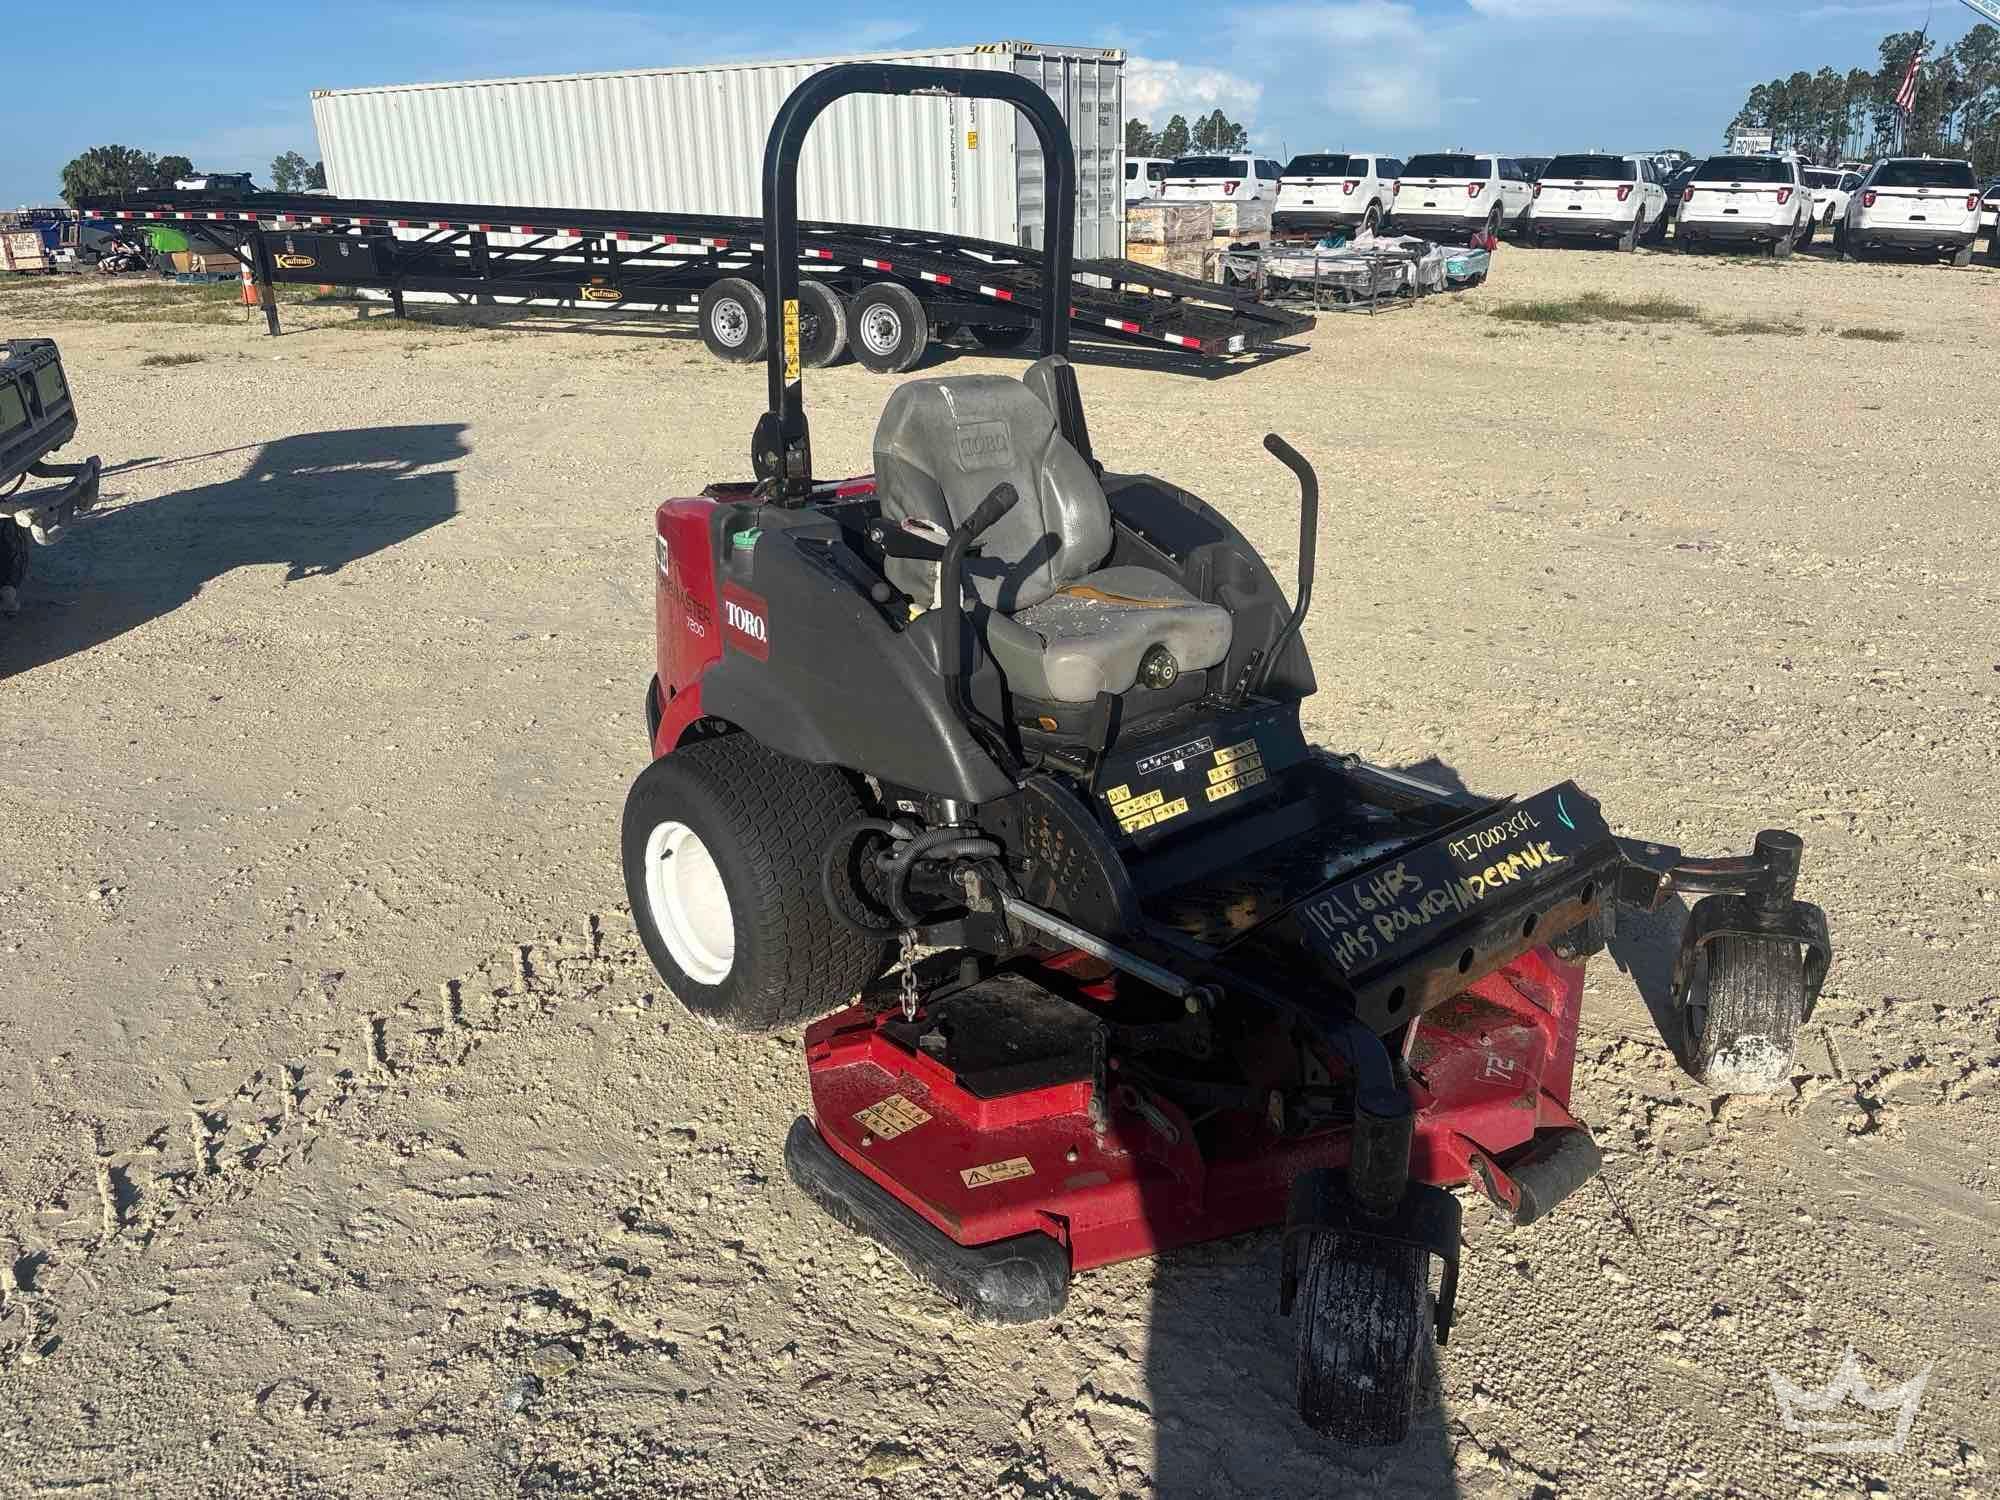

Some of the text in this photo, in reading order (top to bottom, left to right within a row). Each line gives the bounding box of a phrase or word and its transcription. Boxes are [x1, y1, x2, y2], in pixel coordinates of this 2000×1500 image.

[274, 254, 313, 269] Kaufman
[581, 287, 620, 300] Kaufman
[1329, 925, 1378, 971] HAS
[1485, 1056, 1513, 1081] 72
